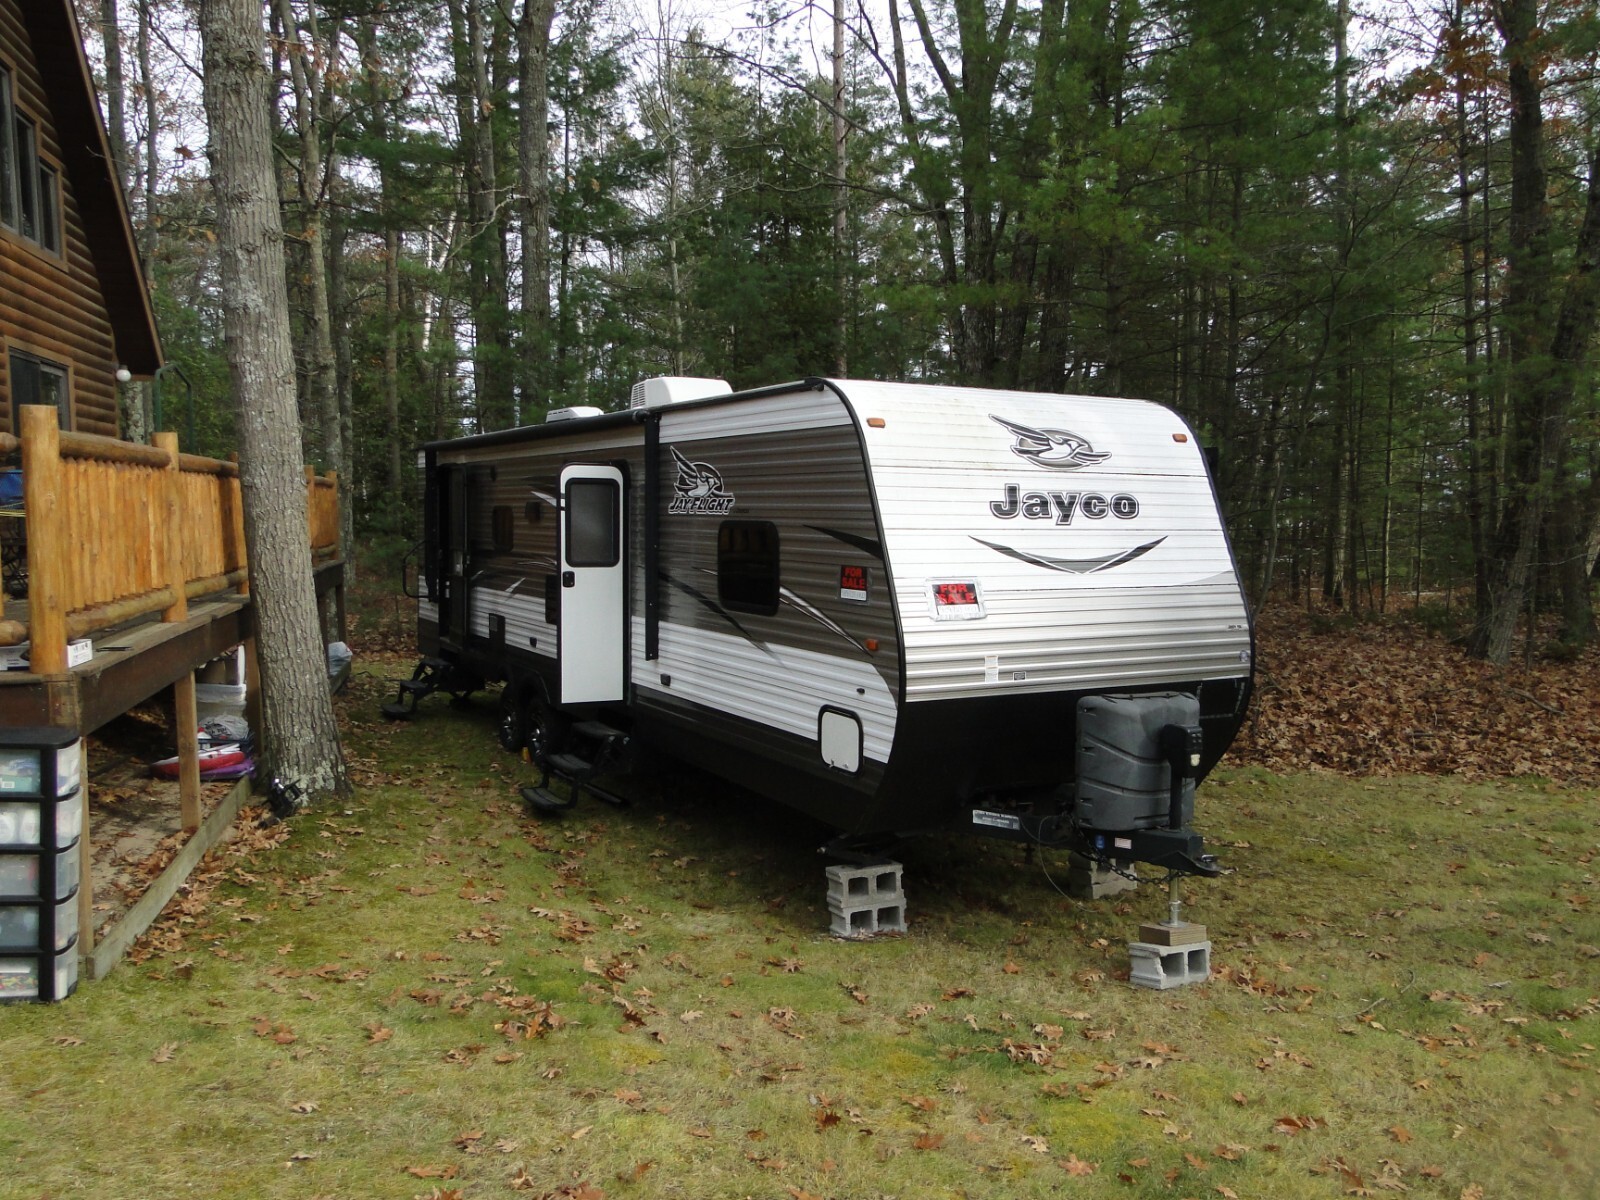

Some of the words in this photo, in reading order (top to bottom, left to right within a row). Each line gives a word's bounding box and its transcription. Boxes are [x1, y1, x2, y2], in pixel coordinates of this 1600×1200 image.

[689, 497, 736, 515] FLIGHT
[989, 483, 1140, 526] Jayco
[844, 567, 863, 577] FOR
[842, 576, 865, 589] SALE
[939, 584, 968, 593] FOR
[936, 592, 976, 604] SALE
